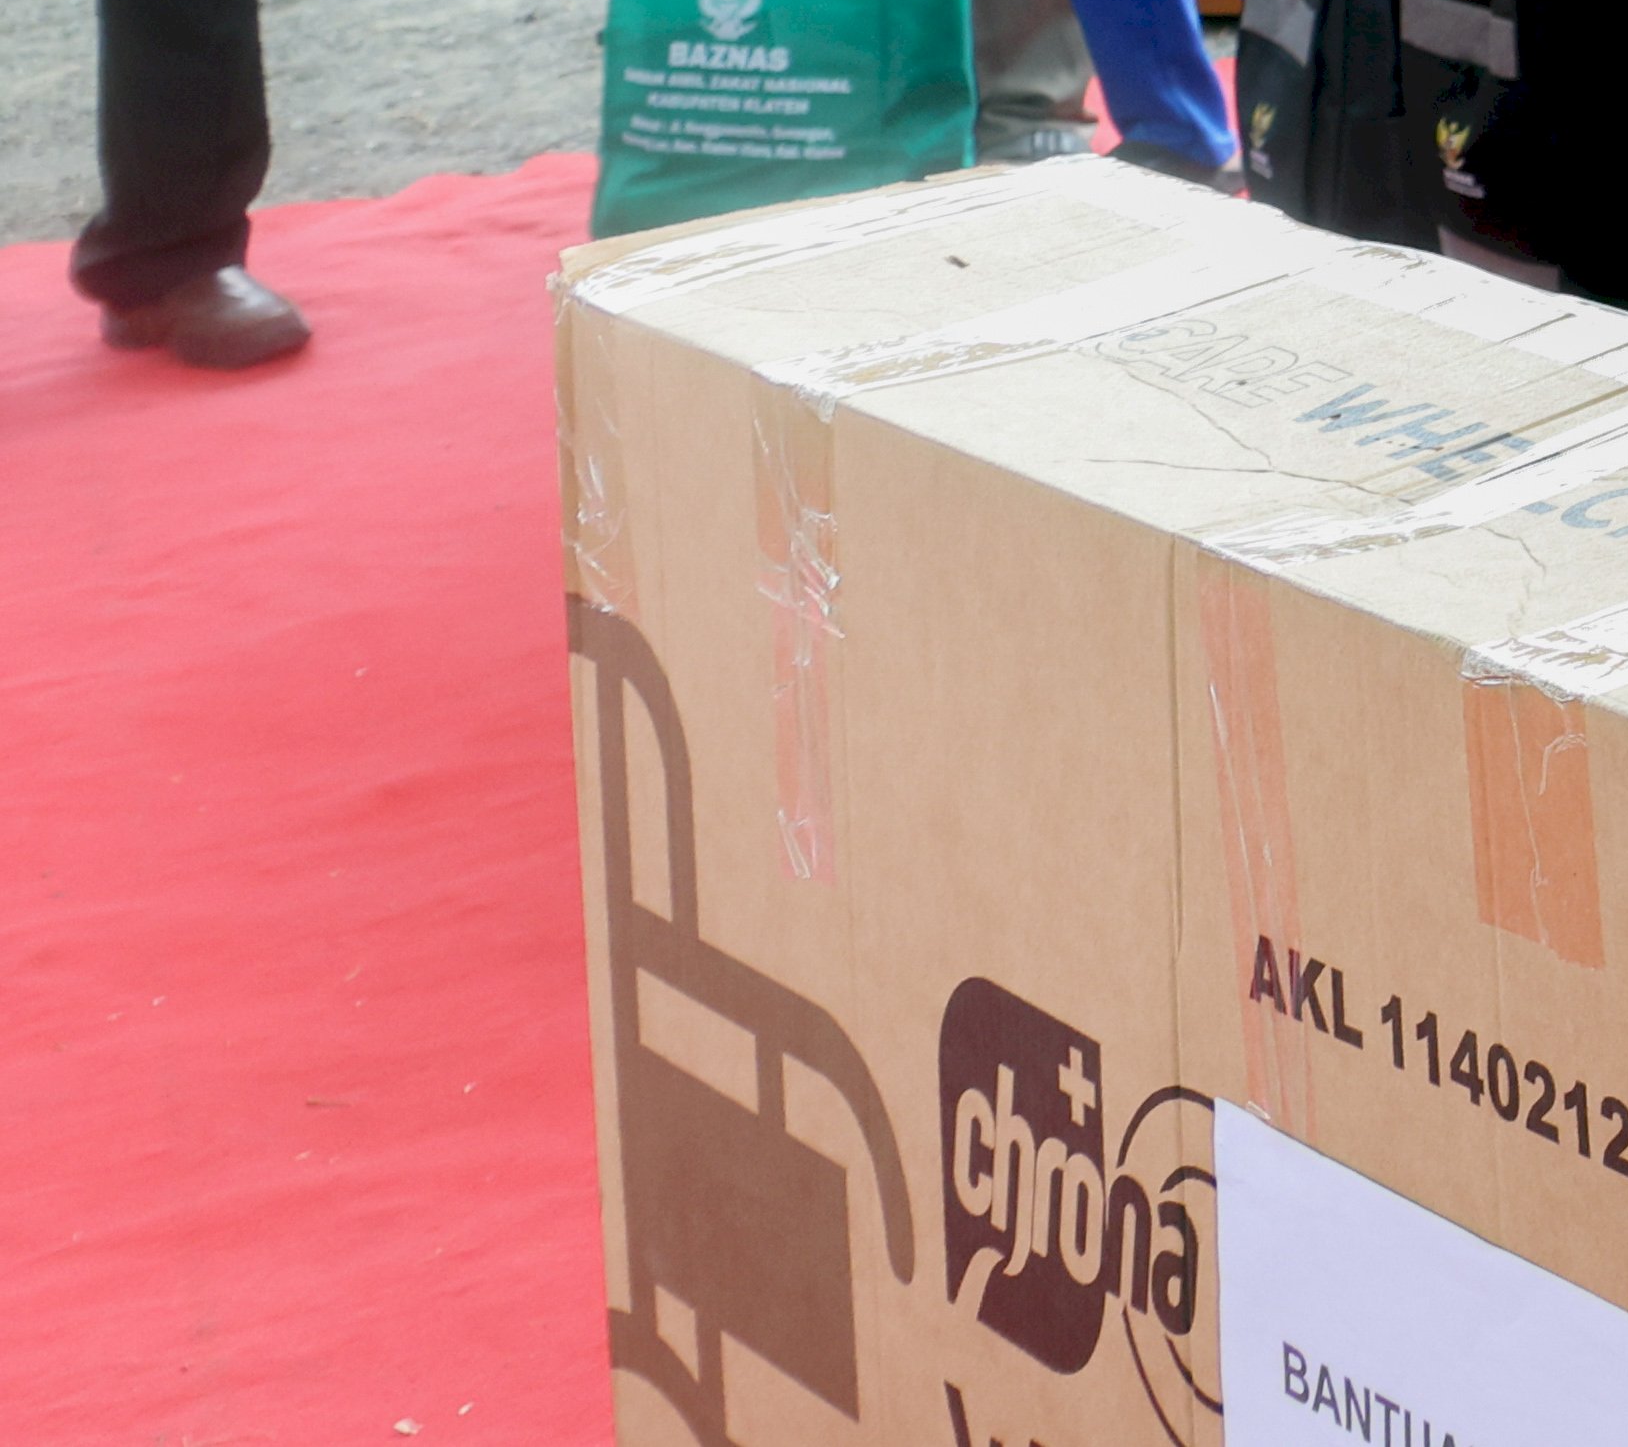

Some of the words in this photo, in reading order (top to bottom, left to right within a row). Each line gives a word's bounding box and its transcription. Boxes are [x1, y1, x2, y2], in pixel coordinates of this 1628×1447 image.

[668, 40, 790, 72] BAZNAS
[1096, 318, 1358, 409] CARE
[1250, 934, 1363, 1050] AKL
[952, 1063, 1199, 1337] chrona
[1282, 1341, 1462, 1447] BANTU
